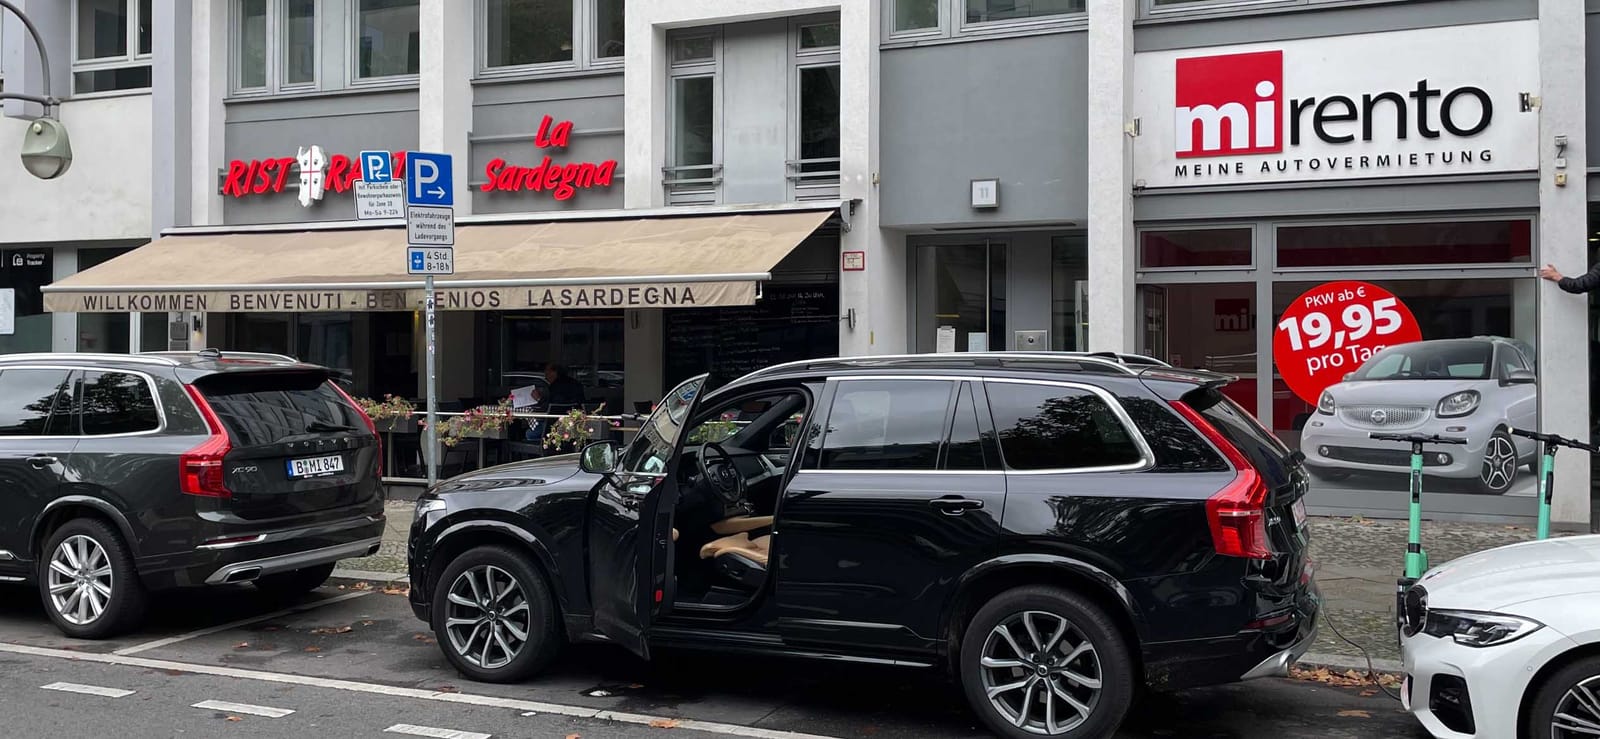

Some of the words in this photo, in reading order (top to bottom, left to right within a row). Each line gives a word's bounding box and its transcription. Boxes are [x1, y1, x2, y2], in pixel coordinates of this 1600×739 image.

[1175, 79, 1493, 152] mirento
[533, 114, 574, 148] La
[368, 155, 384, 180] P
[1175, 161, 1244, 177] MEINE
[1260, 149, 1493, 174] AUTOVERMIETUNG
[414, 158, 439, 198] P
[480, 155, 617, 201] Sardegna
[410, 211, 451, 221] Elektrofahrzeuge
[414, 232, 448, 241] Ladevorgangs
[427, 251, 432, 260] 4
[83, 294, 207, 310] WILLKOMMEN
[230, 292, 341, 310] BENVENUTI
[527, 286, 697, 307] LASARDEGNA
[1304, 292, 1334, 308] PKW
[1337, 288, 1354, 301] ab
[1356, 286, 1366, 298] €
[1279, 297, 1402, 351] 19,95
[1306, 352, 1344, 376] pro
[231, 465, 258, 475] XC90
[296, 461, 304, 474] B
[308, 459, 322, 472] MI
[323, 457, 339, 471] 847
